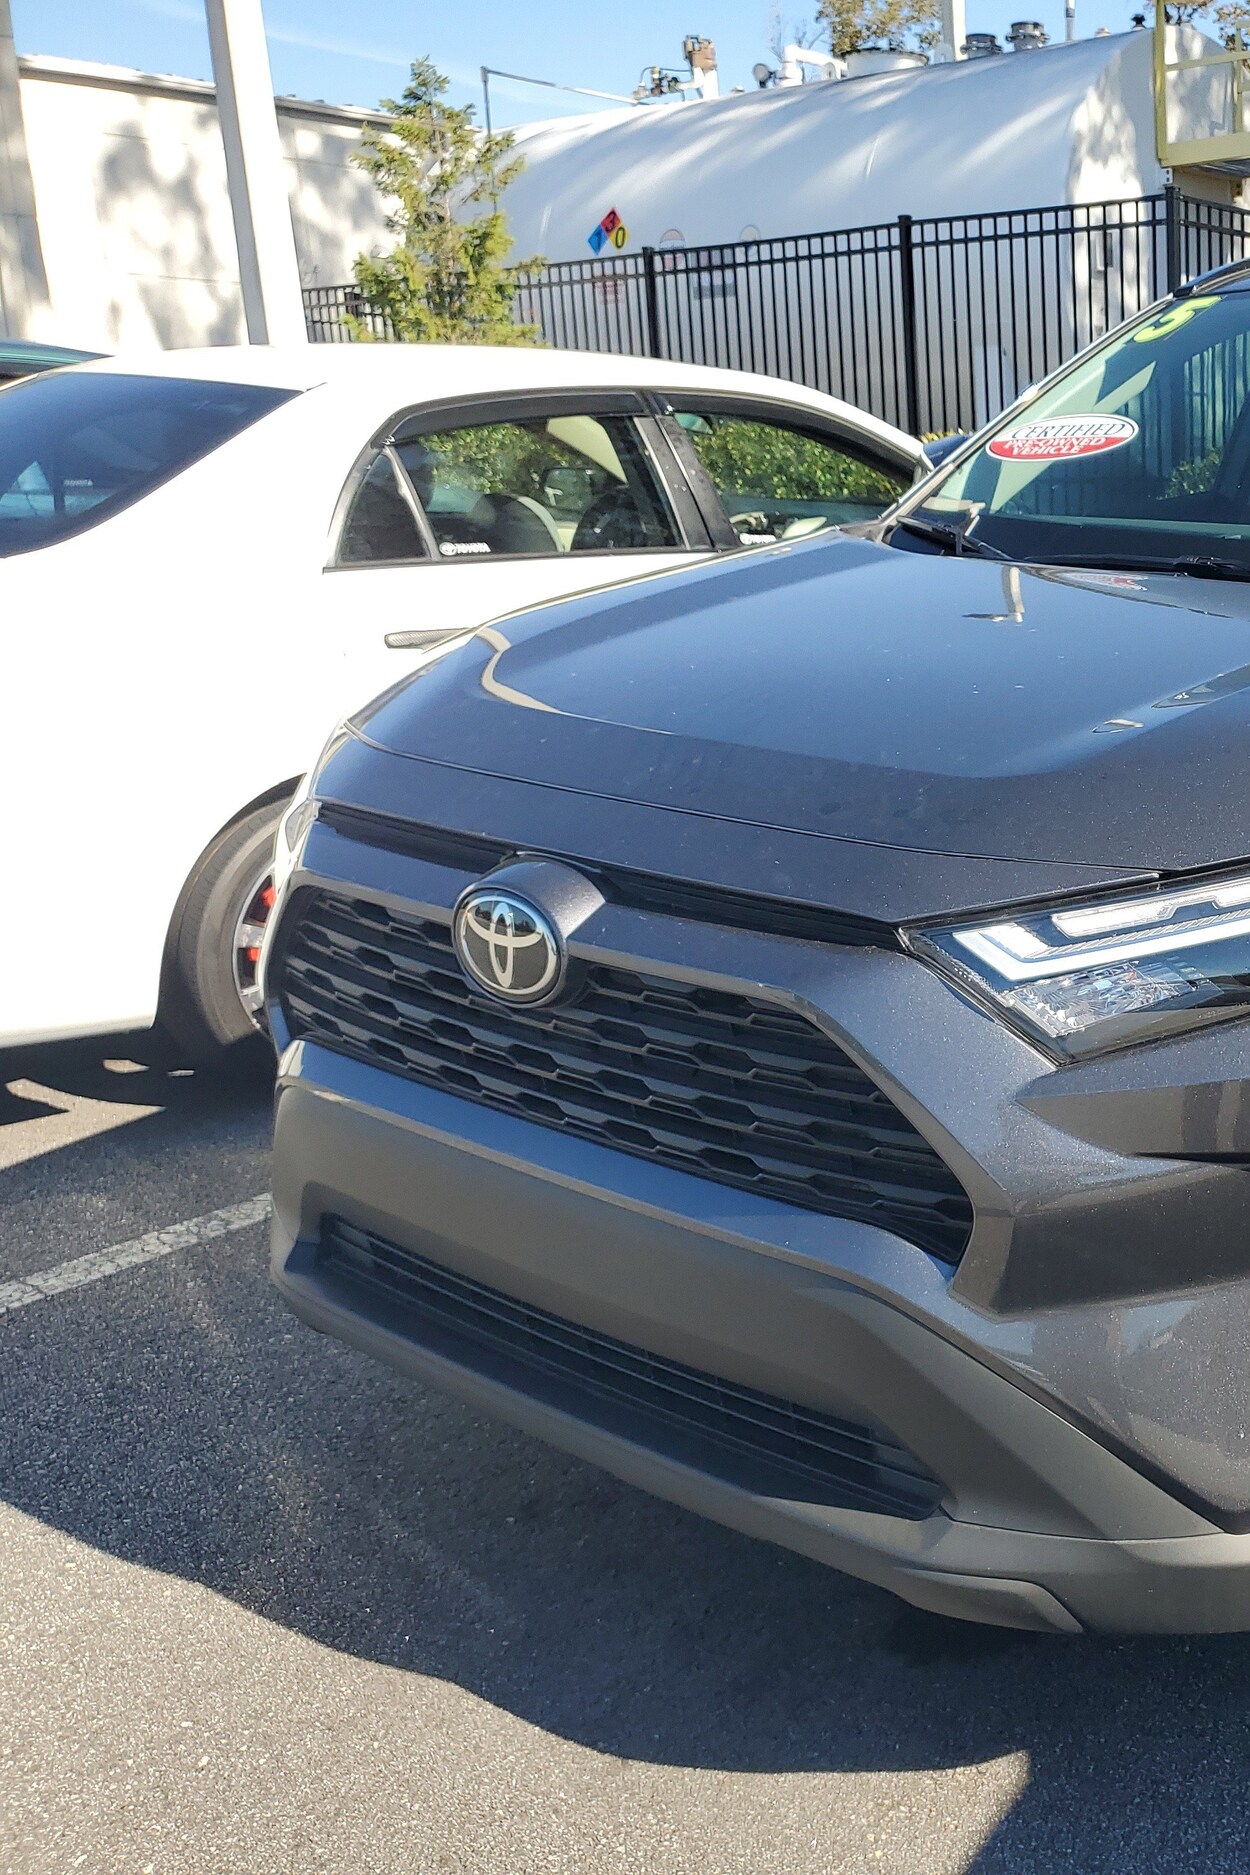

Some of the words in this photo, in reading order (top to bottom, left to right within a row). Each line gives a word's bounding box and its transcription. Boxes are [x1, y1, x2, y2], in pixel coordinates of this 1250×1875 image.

[603, 210, 617, 233] 3
[615, 226, 626, 249] 0
[1012, 423, 1126, 439] CERTIFIED
[1003, 437, 1107, 449] PRE-OWNED
[1012, 446, 1081, 455] VEHICLE
[455, 542, 492, 554] TOYOTA
